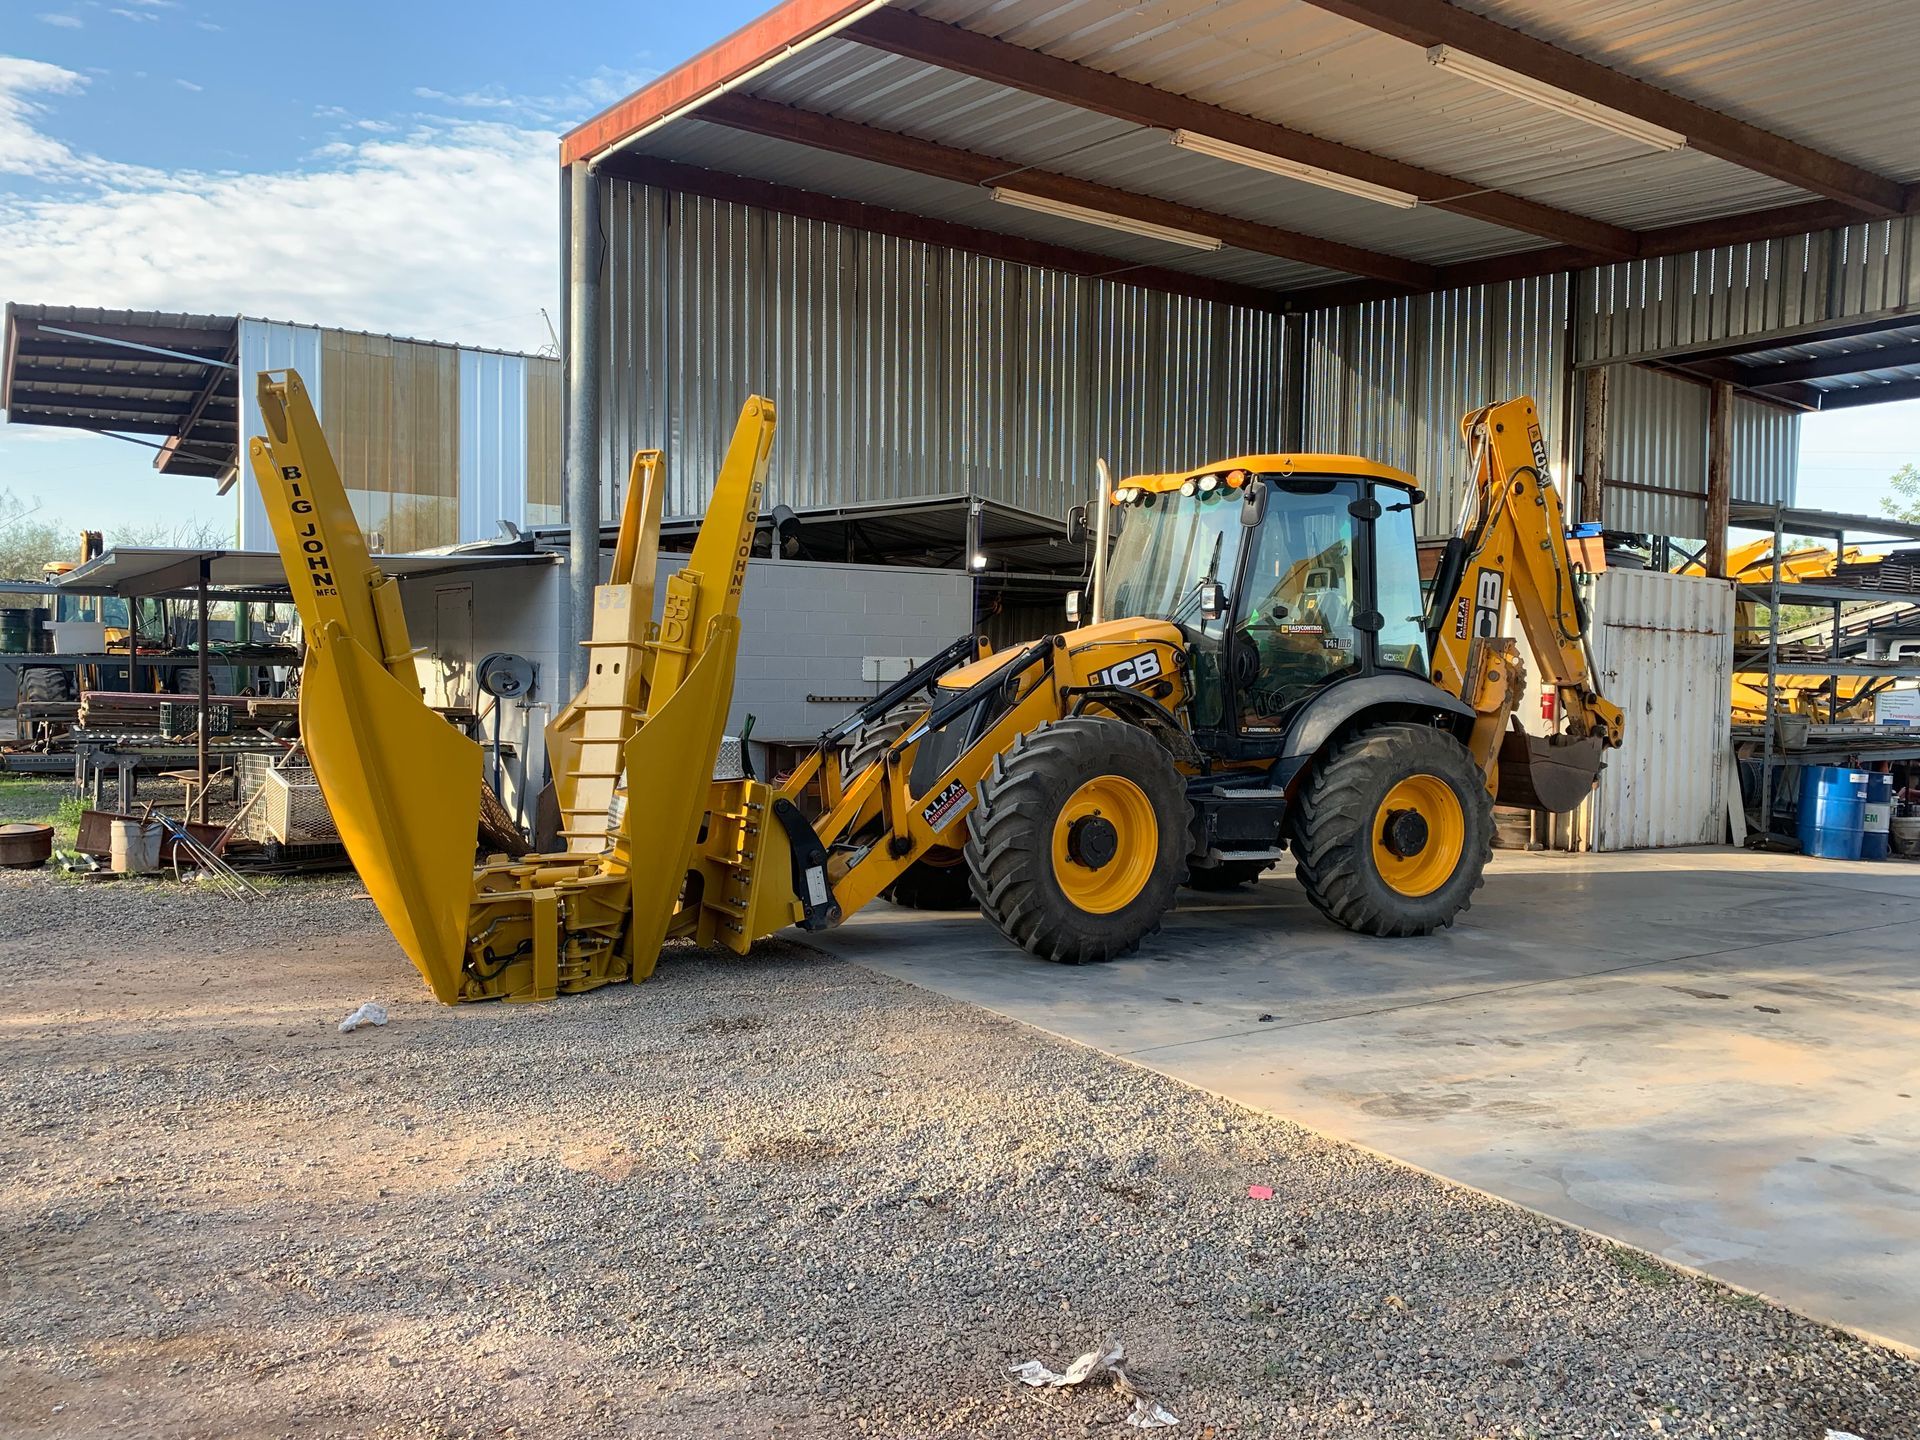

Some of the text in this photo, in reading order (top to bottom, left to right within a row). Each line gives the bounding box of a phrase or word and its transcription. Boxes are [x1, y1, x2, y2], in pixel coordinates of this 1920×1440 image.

[281, 465, 334, 587] BIG JOHN
[730, 481, 762, 587] BIG JOHN
[315, 588, 337, 597] MFG
[664, 595, 691, 621] 55
[1474, 571, 1502, 638] CB
[666, 619, 684, 643] D
[1323, 639, 1337, 649] T4i
[924, 783, 962, 819] A.L.P.A.
[928, 797, 955, 824] EQUIPMENT
[954, 788, 965, 800] LTD
